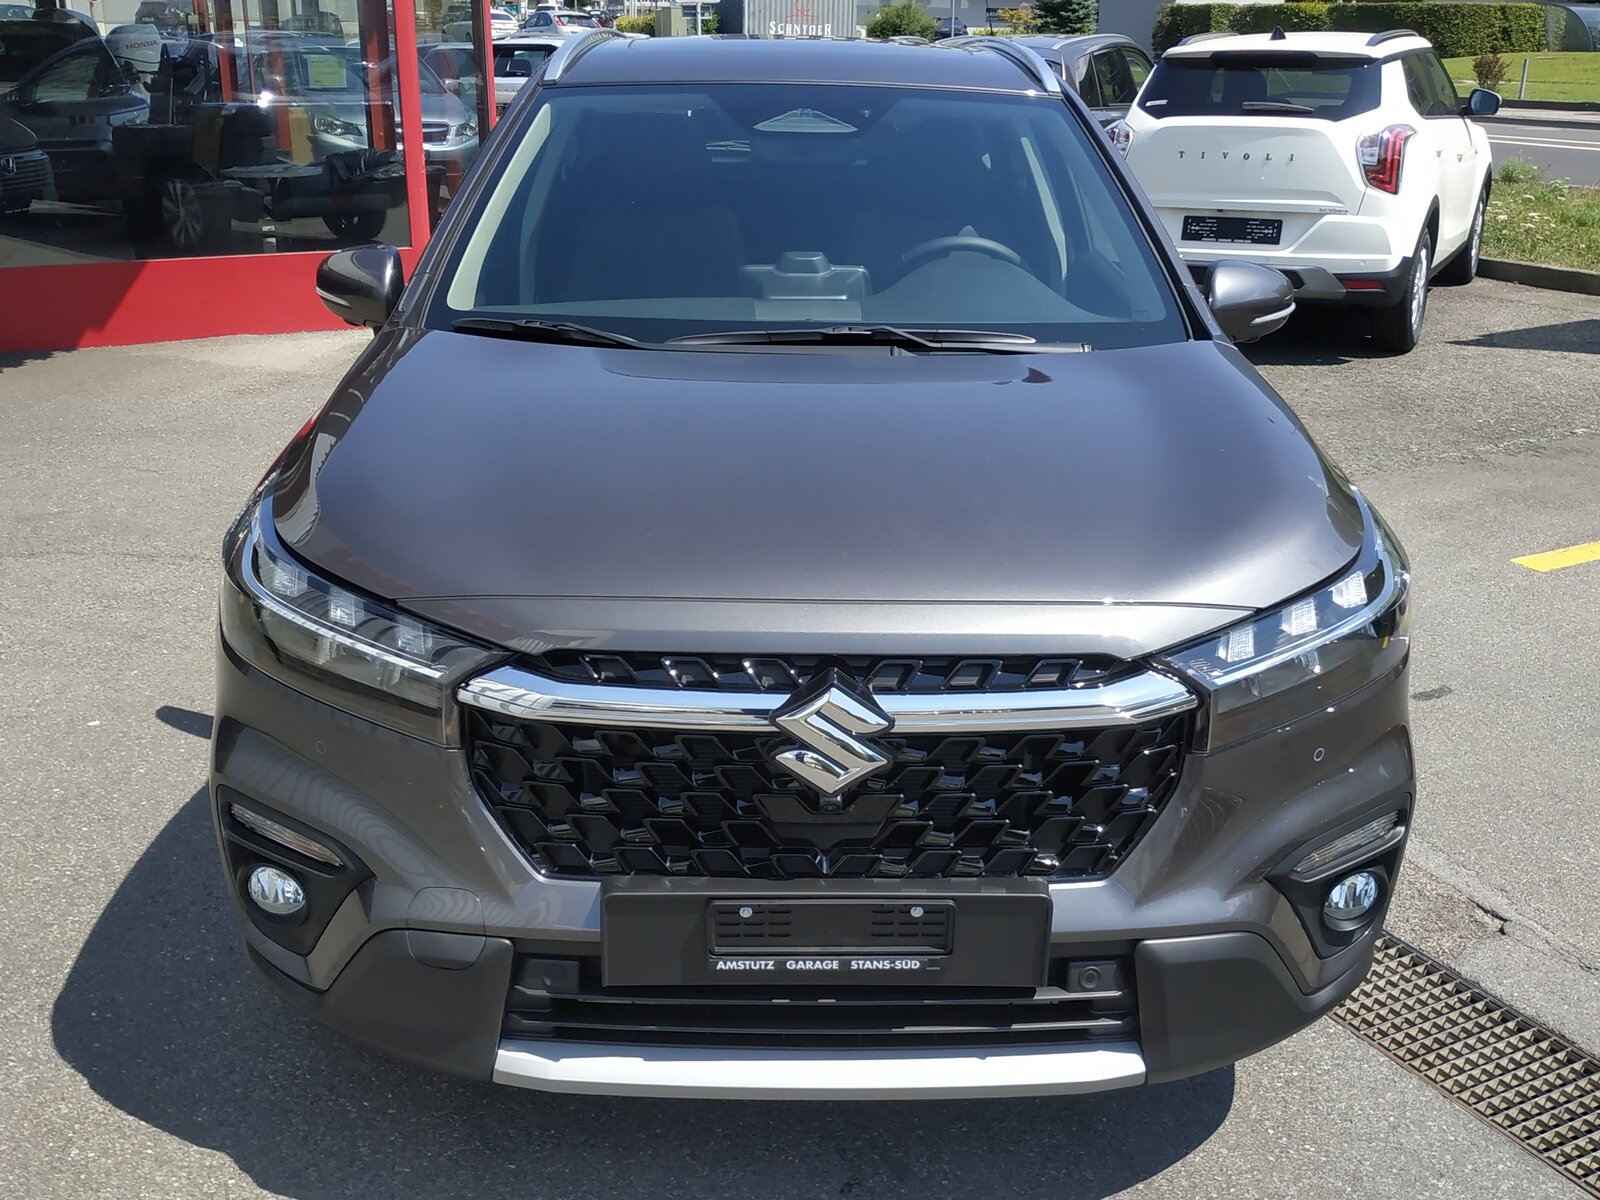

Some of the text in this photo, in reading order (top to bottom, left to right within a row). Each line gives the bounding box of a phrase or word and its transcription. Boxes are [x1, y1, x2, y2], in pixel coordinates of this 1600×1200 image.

[125, 40, 158, 50] HONDA
[1178, 150, 1294, 162] TIVOLI
[716, 959, 920, 970] AMSTUTZ GARAGE STANS-SÜD
